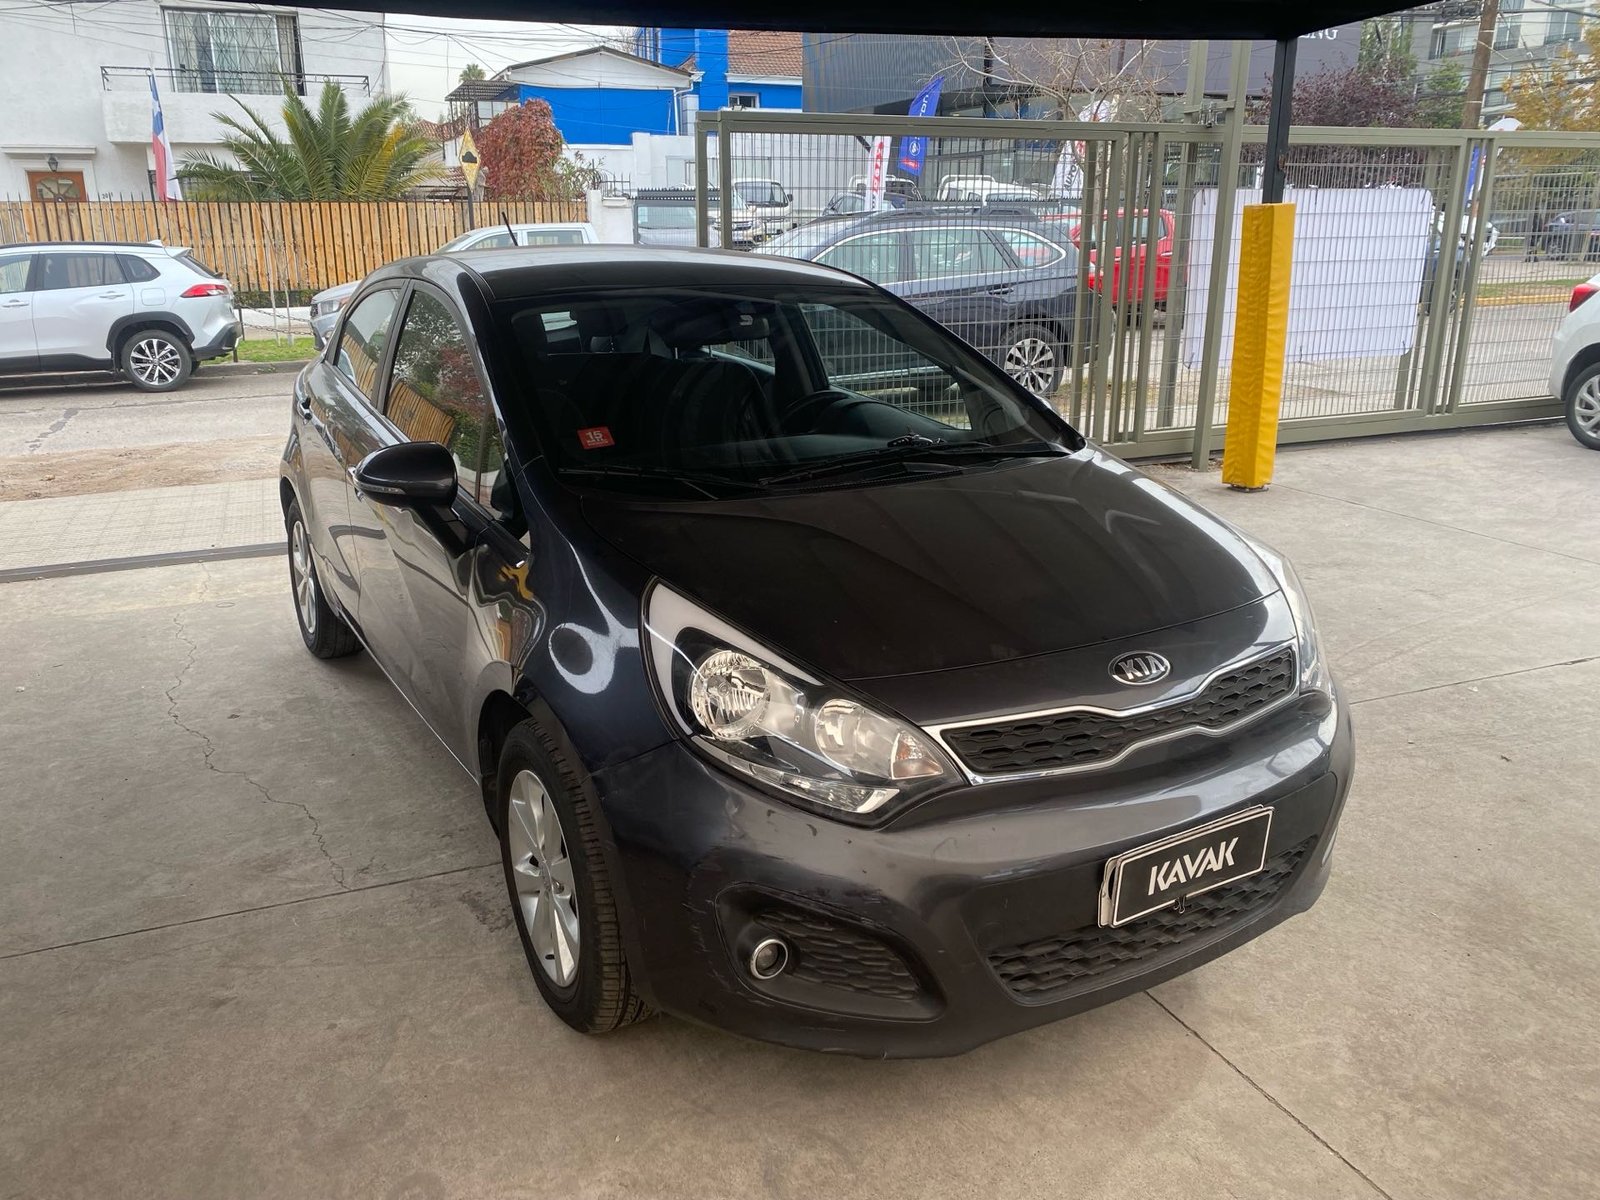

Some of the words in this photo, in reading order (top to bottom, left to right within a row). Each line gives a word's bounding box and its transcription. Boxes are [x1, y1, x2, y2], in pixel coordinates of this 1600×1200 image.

[586, 430, 603, 440] 15
[1117, 655, 1166, 680] KIA
[1147, 836, 1239, 896] KAVAK
